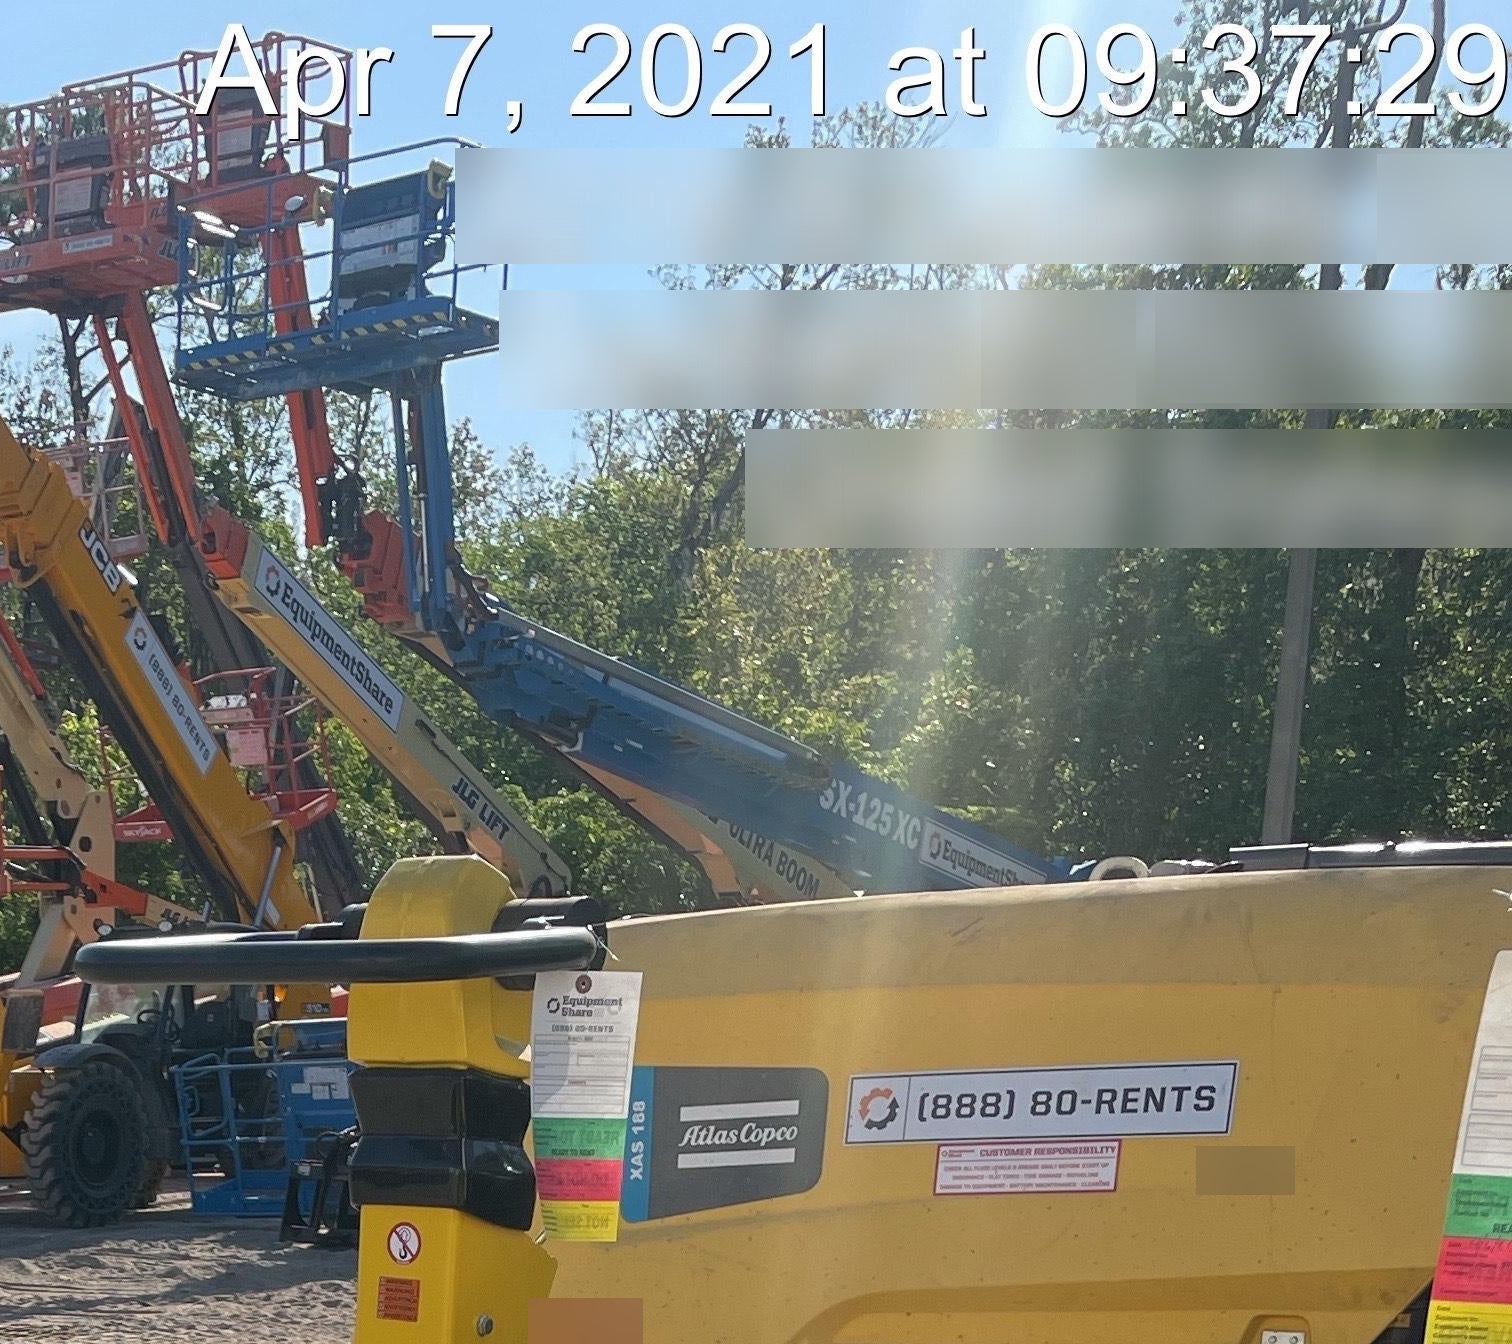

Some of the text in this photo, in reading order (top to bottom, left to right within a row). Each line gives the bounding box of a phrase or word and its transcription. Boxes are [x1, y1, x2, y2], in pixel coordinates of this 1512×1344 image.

[78, 525, 122, 593] JCB
[279, 582, 394, 715] EquipmentShare
[478, 806, 511, 841] LIFT
[890, 809, 922, 850] XC
[775, 847, 820, 898] BOOM
[561, 1006, 593, 1017] Share
[562, 995, 623, 1008] Equipment
[917, 1085, 1217, 1122] (888) 80-RENTS
[630, 1100, 647, 1181] XAS 188
[678, 1122, 799, 1147] Atlas Copco
